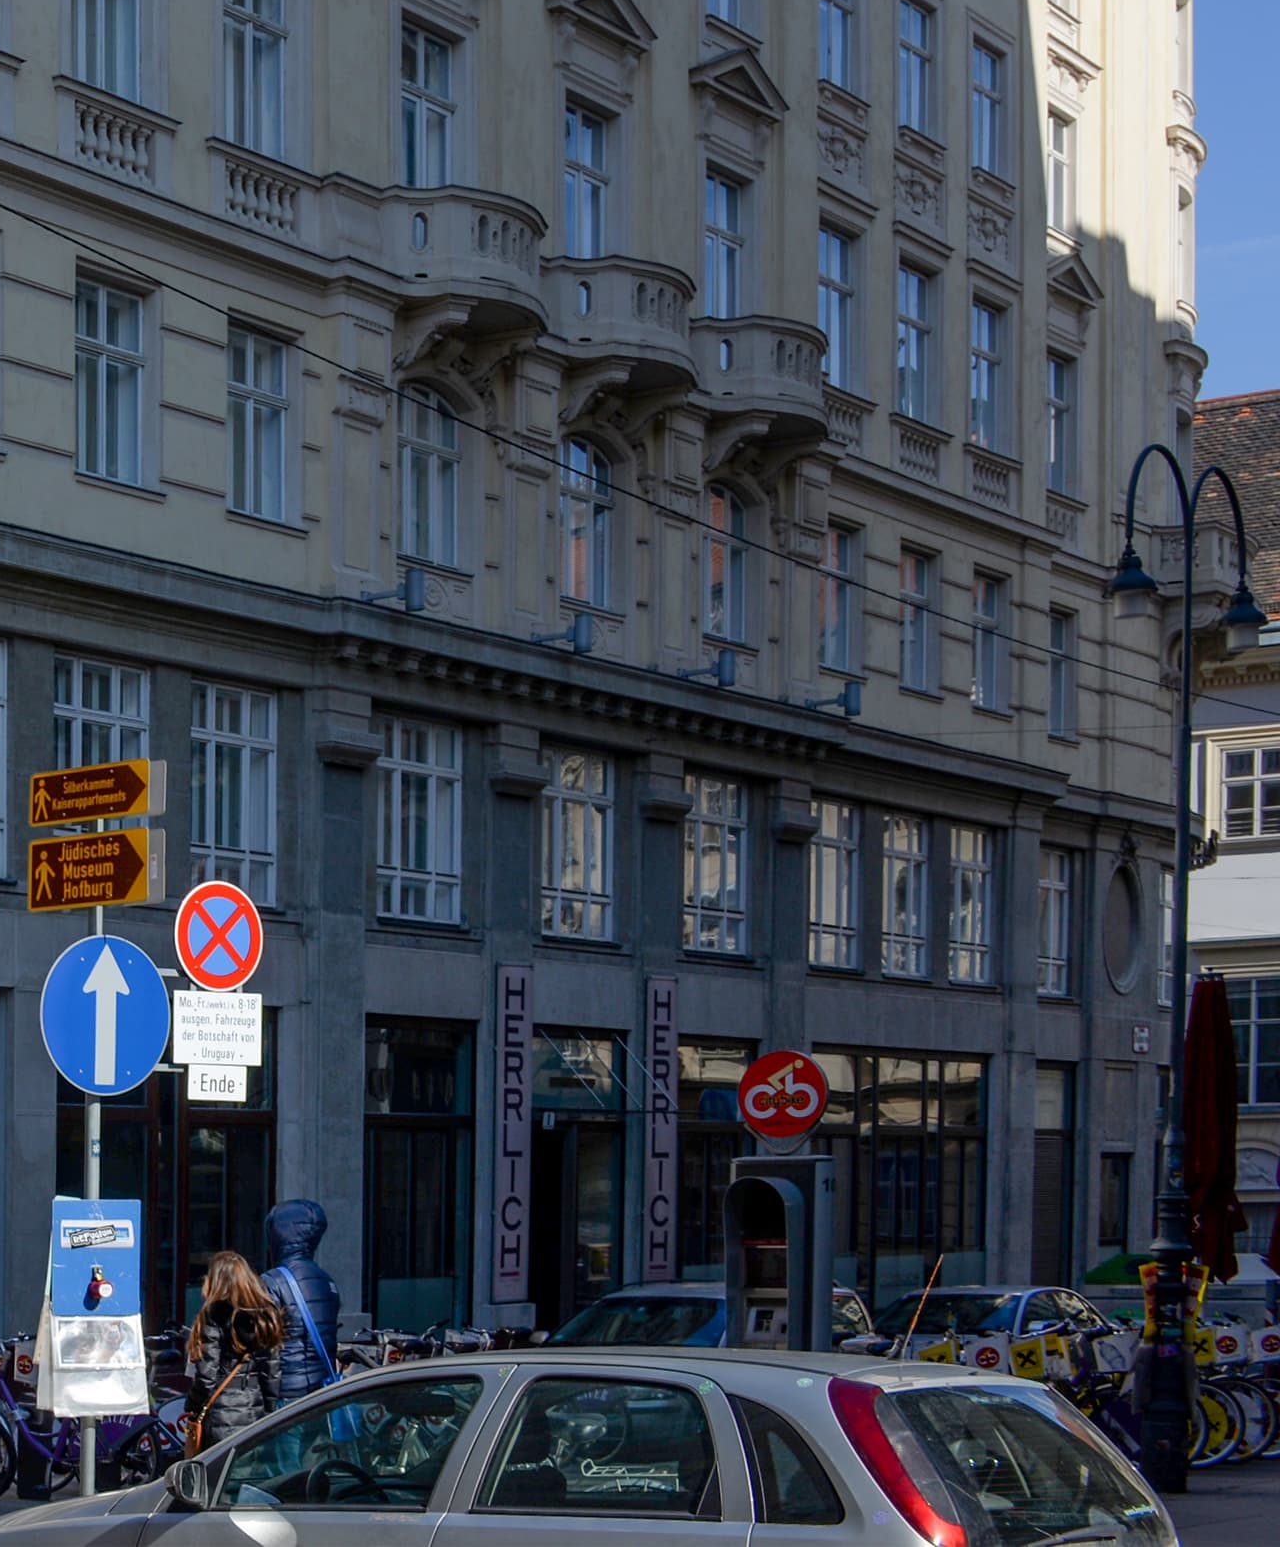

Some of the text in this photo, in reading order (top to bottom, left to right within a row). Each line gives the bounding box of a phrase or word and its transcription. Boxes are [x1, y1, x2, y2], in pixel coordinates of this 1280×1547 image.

[63, 778, 115, 794] Silberkammer
[51, 791, 127, 810] Kaiserappartements
[58, 839, 120, 862] Jüdisches
[63, 861, 114, 880] Museum
[63, 881, 113, 900] Hofburg
[215, 1013, 256, 1028] Fahrzeuge
[182, 1030, 255, 1043] der Botschaft von
[201, 1047, 236, 1061] Uruguay
[200, 1073, 235, 1093] Ende
[759, 1096, 805, 1108] citybike
[500, 976, 525, 1269] HERRLICH
[649, 989, 671, 1262] HERRLICH
